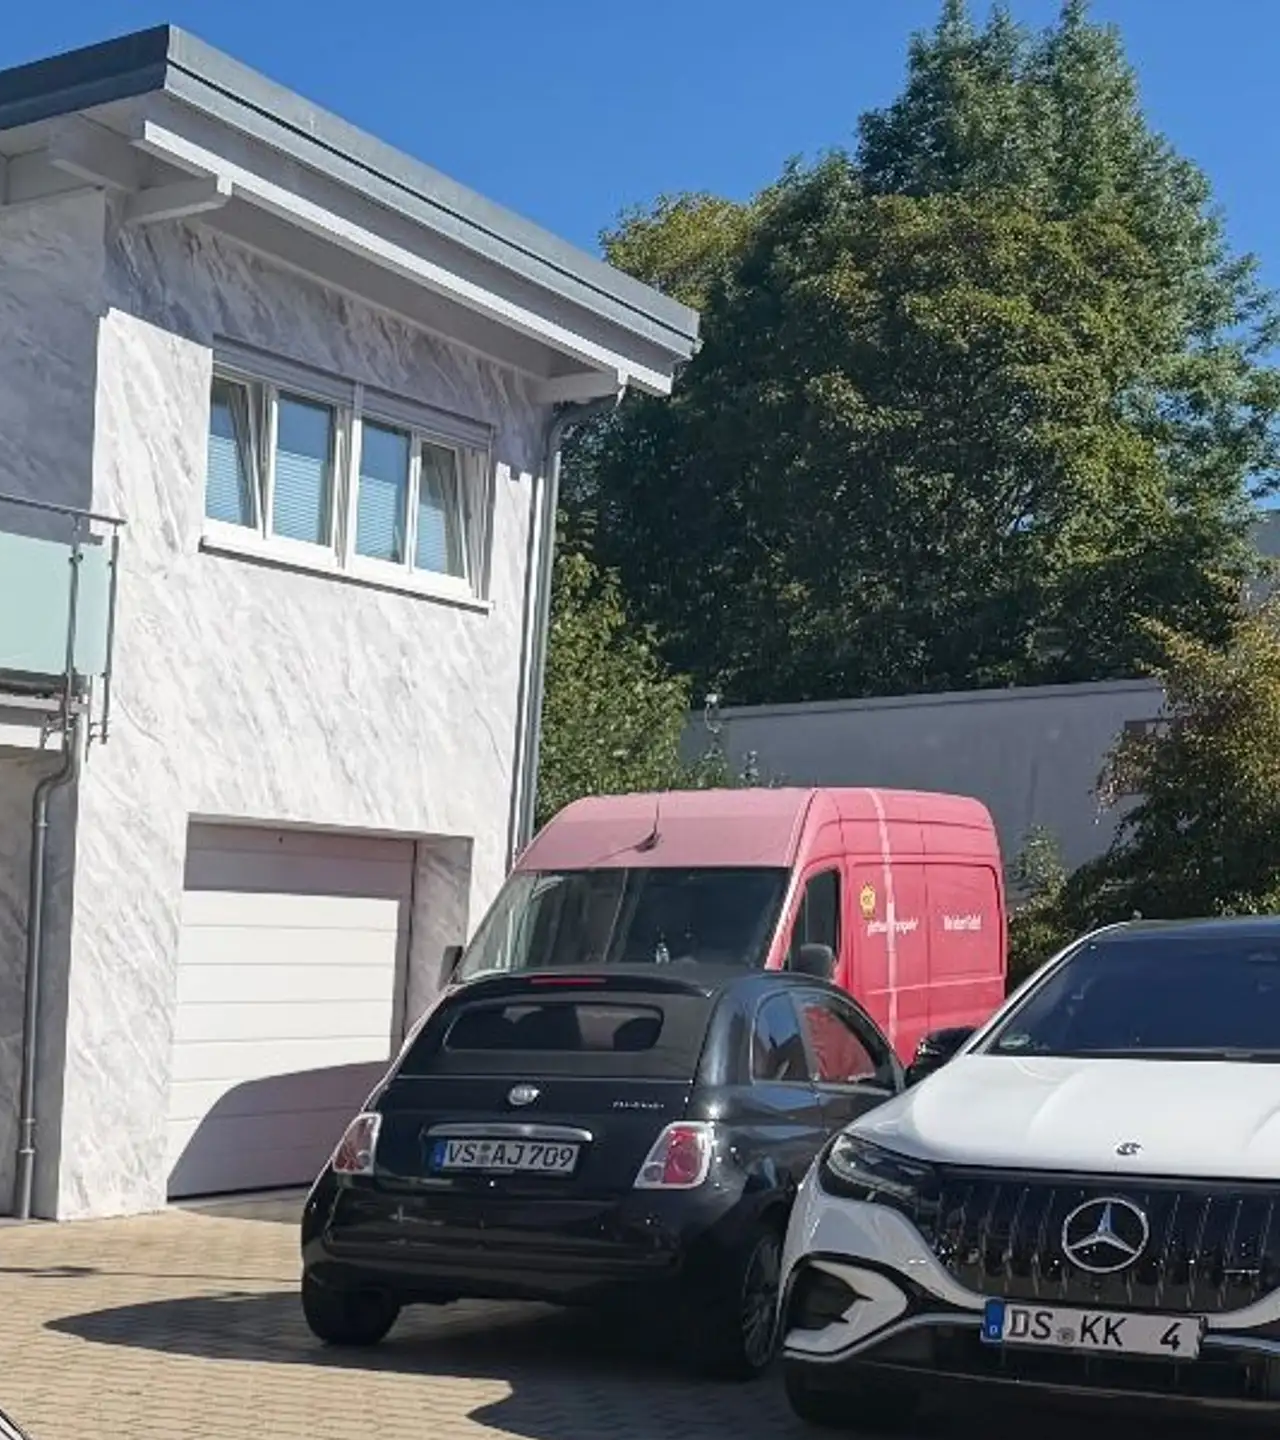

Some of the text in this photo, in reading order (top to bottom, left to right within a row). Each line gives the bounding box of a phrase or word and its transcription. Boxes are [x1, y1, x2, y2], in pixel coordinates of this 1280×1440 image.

[448, 1141, 574, 1168] VS AJ 709
[1007, 1308, 1054, 1340] DS
[1079, 1315, 1128, 1348] KK
[1160, 1321, 1184, 1351] 4
